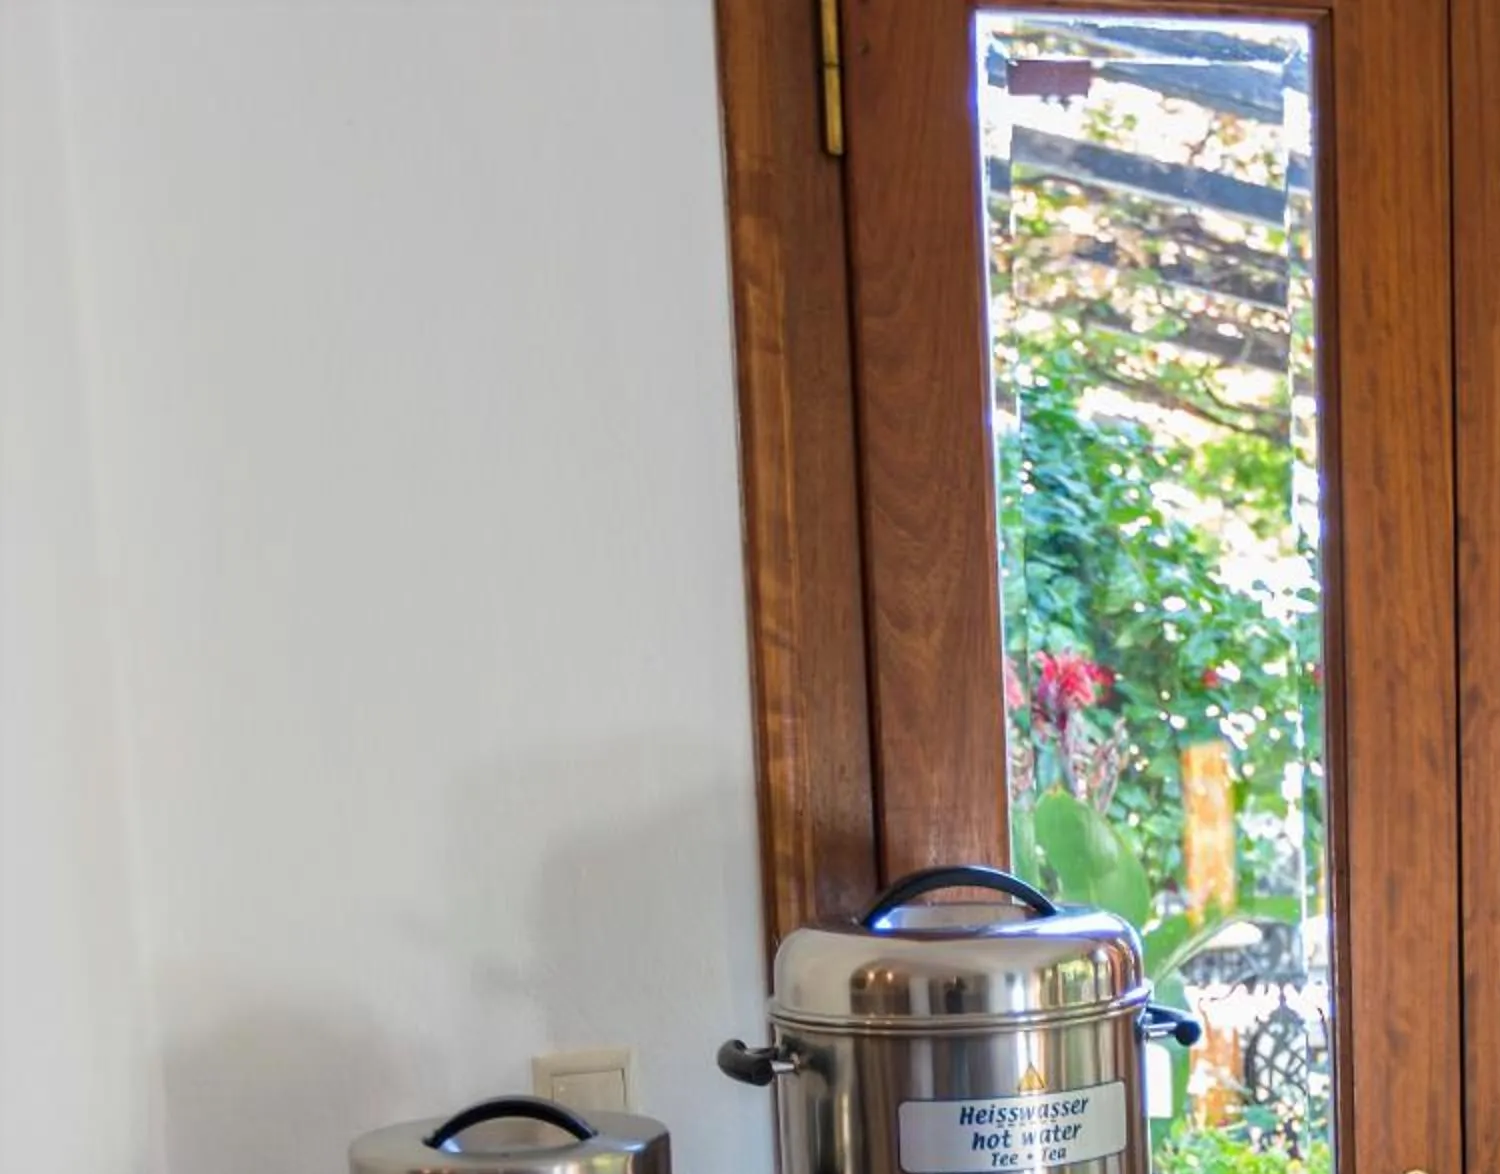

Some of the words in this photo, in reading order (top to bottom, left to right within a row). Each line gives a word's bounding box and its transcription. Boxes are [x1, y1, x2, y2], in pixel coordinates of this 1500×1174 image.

[959, 1097, 1089, 1125] Heisswasser
[972, 1129, 1012, 1150] hot
[1022, 1123, 1082, 1145] water
[991, 1152, 1018, 1166] Tee
[1042, 1147, 1067, 1161] Tea
